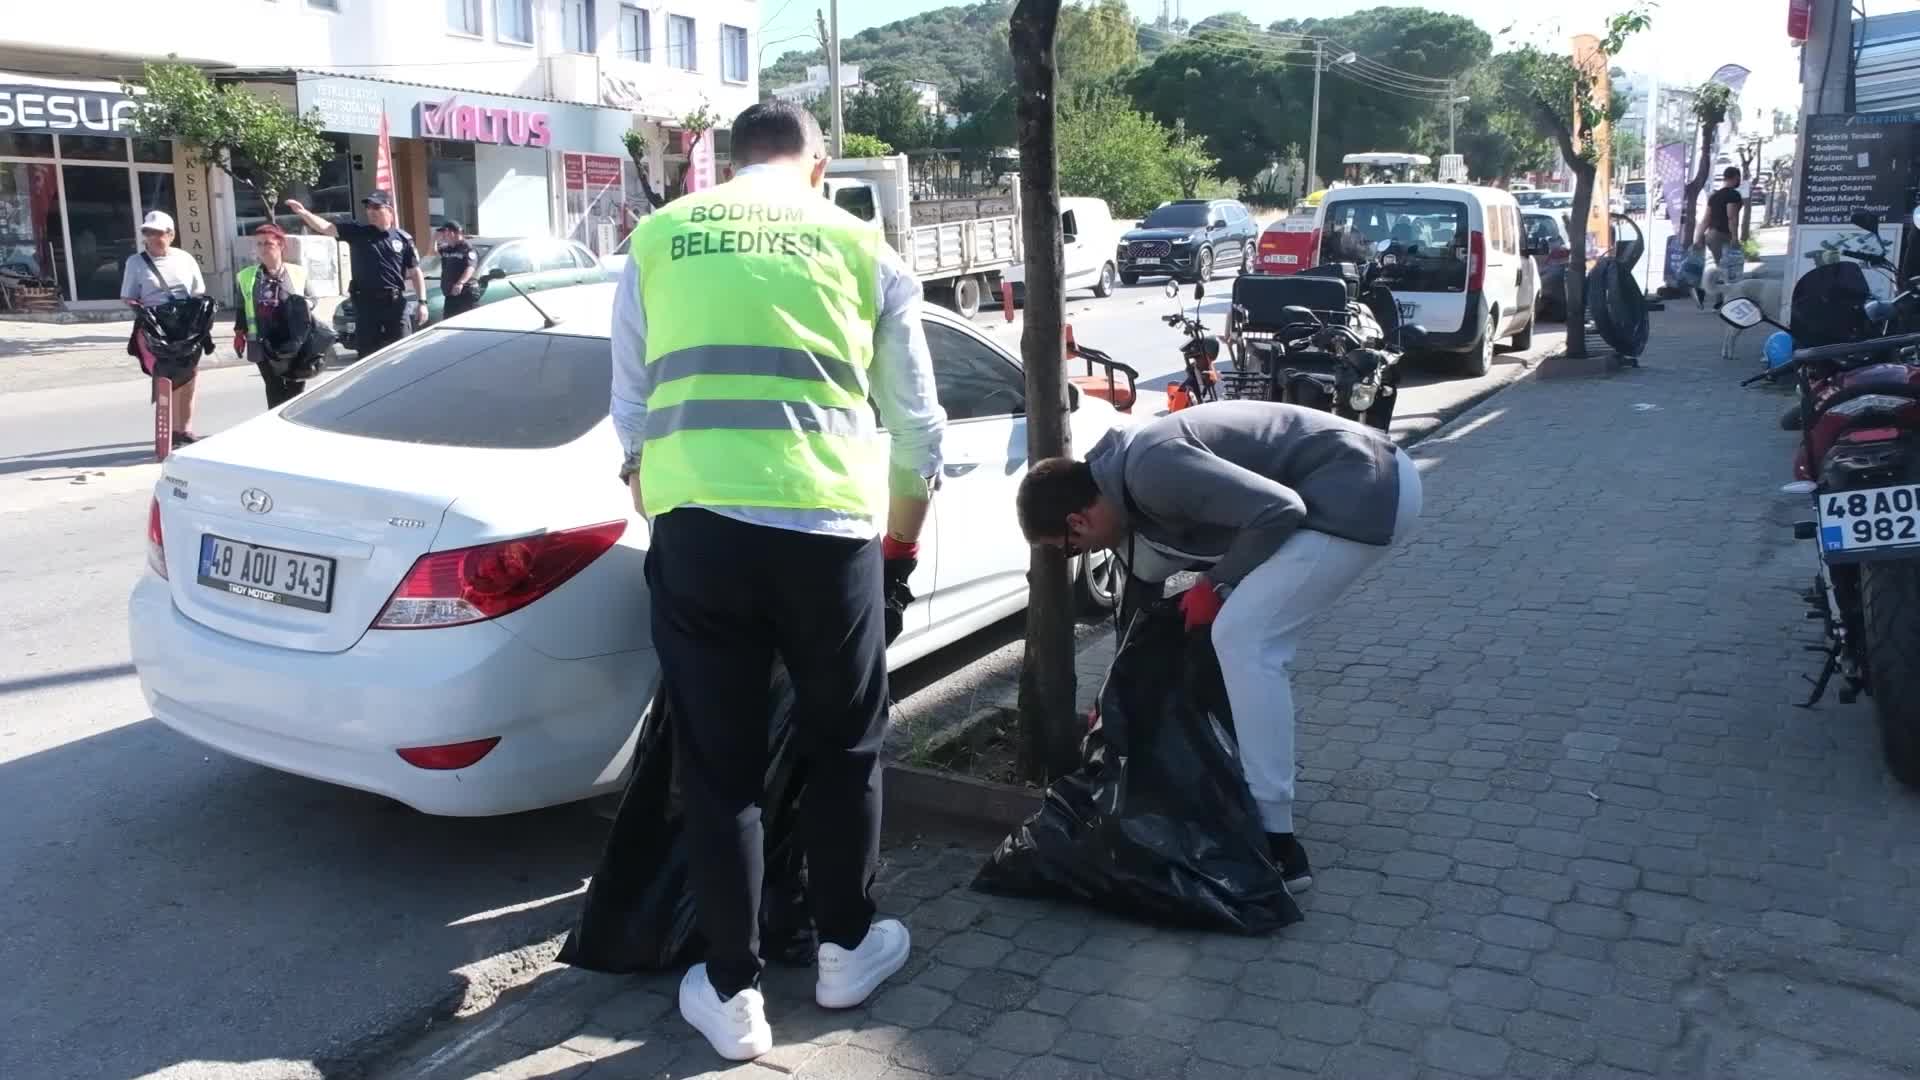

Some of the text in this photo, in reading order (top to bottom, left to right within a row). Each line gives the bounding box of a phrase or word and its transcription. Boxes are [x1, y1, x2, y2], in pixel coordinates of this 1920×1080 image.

[0, 92, 166, 132] SESUA
[452, 104, 551, 146] ALTUS
[690, 203, 804, 223] BODRUM
[670, 227, 822, 261] BELEDİYESİ
[1826, 494, 1867, 519] 48
[1853, 515, 1916, 543] 982
[211, 543, 325, 597] 48 AOU 343
